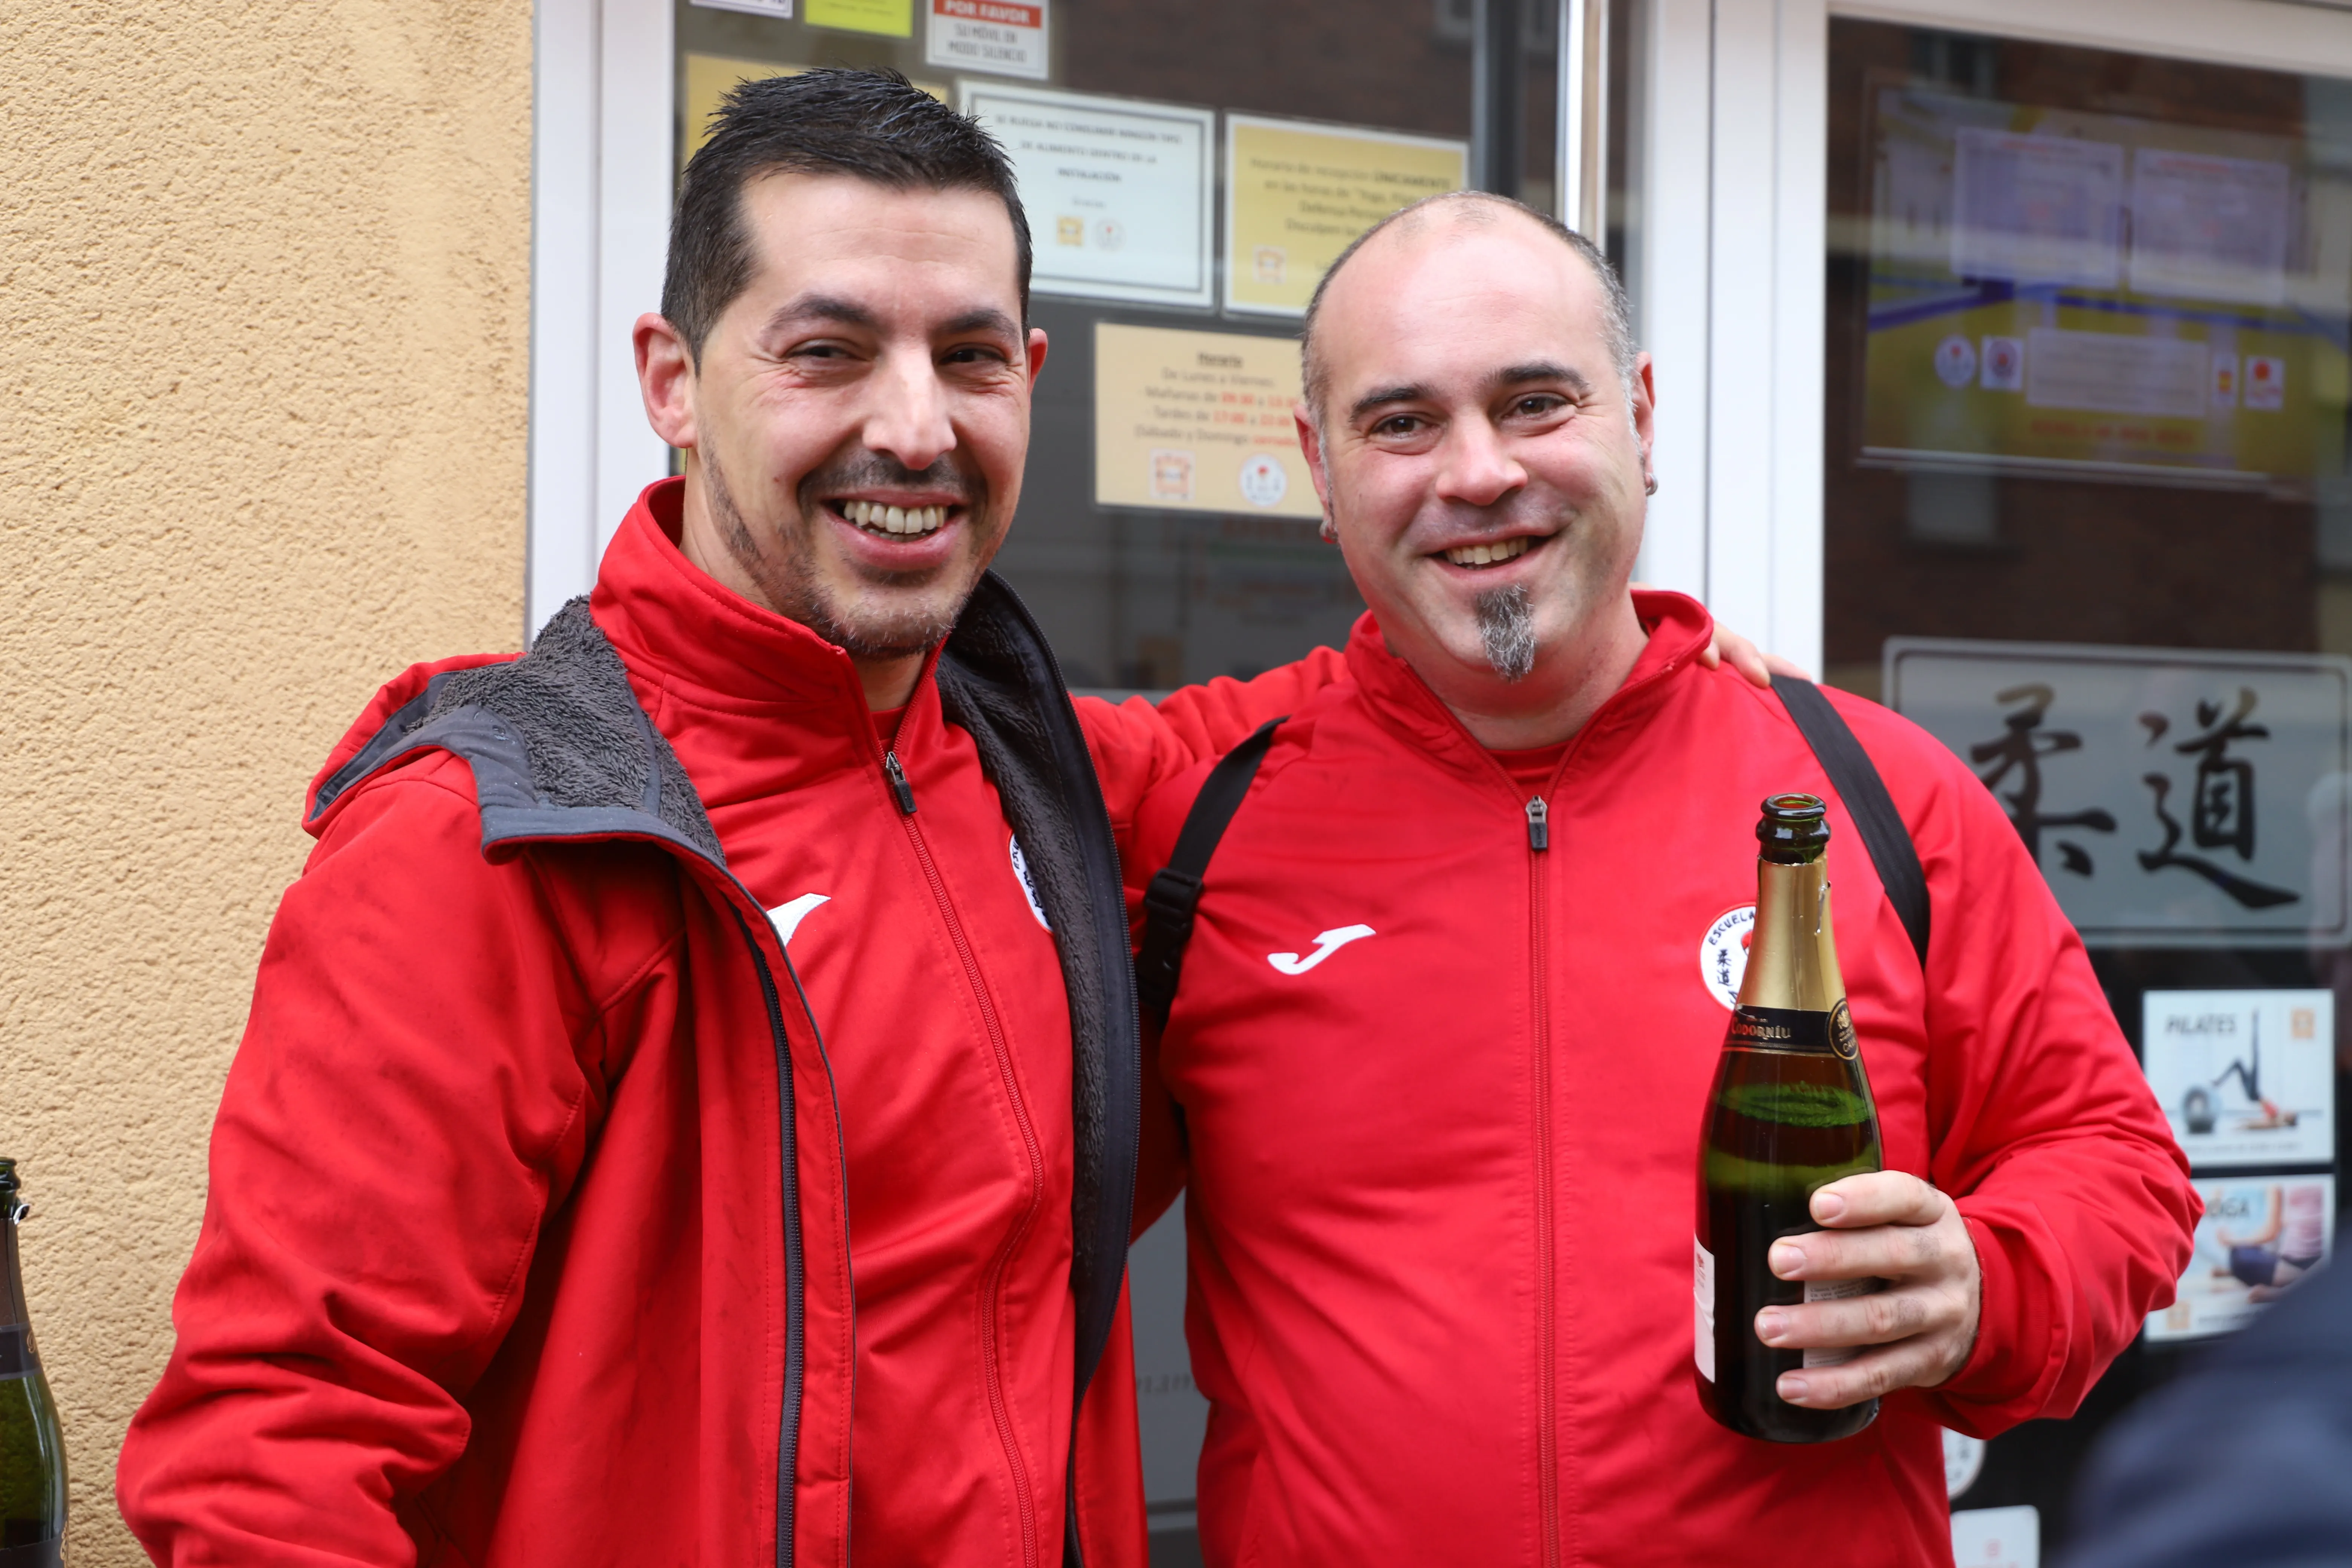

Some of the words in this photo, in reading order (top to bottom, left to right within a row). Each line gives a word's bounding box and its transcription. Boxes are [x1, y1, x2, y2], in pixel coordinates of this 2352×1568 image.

[945, 0, 976, 16] POR
[980, 3, 1029, 23] FAVOR
[955, 23, 970, 36] SU
[1004, 30, 1017, 43] EN
[946, 40, 978, 55] MODO
[982, 44, 1027, 63] SILENCIO
[1058, 167, 1122, 182] INSTALACIÓN
[1198, 352, 1242, 368] Horario
[2167, 1014, 2236, 1035] PILATES
